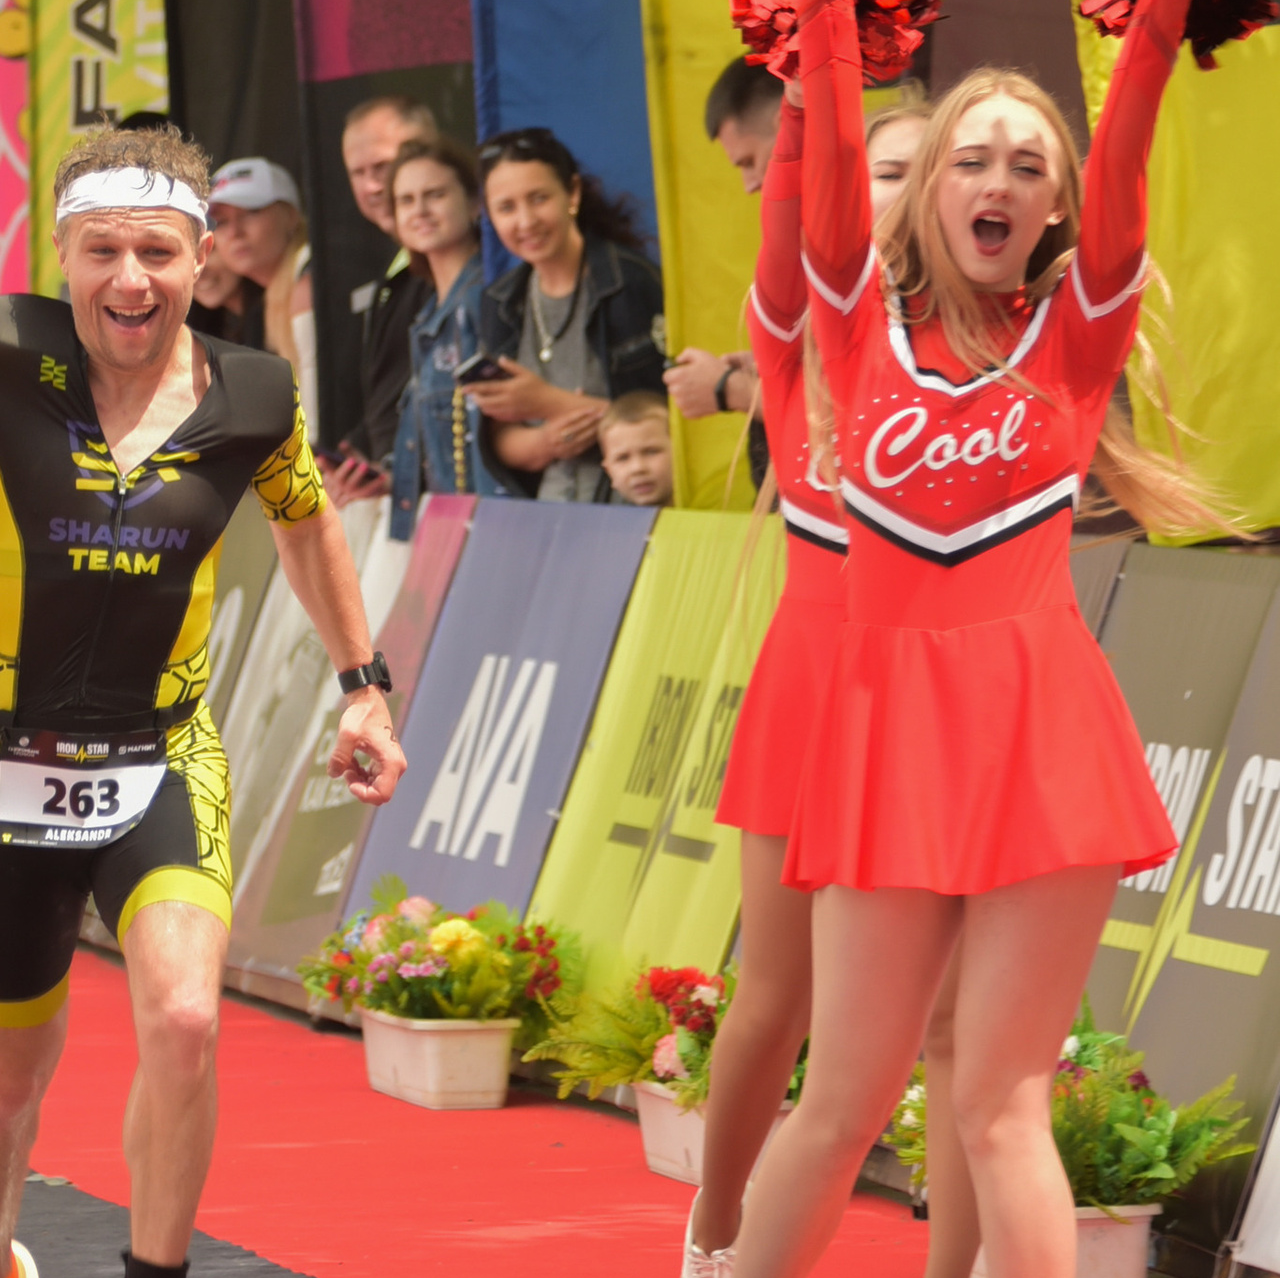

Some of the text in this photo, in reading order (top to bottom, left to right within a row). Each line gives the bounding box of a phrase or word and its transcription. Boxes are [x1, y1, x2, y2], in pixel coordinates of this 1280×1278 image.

[863, 398, 1030, 489] Cool
[48, 517, 190, 551] SHARUN
[67, 547, 161, 576] TEAM
[56, 741, 110, 755] IRON STAR
[408, 653, 558, 867] AVA
[42, 777, 120, 819] 263
[1202, 754, 1280, 916] STA
